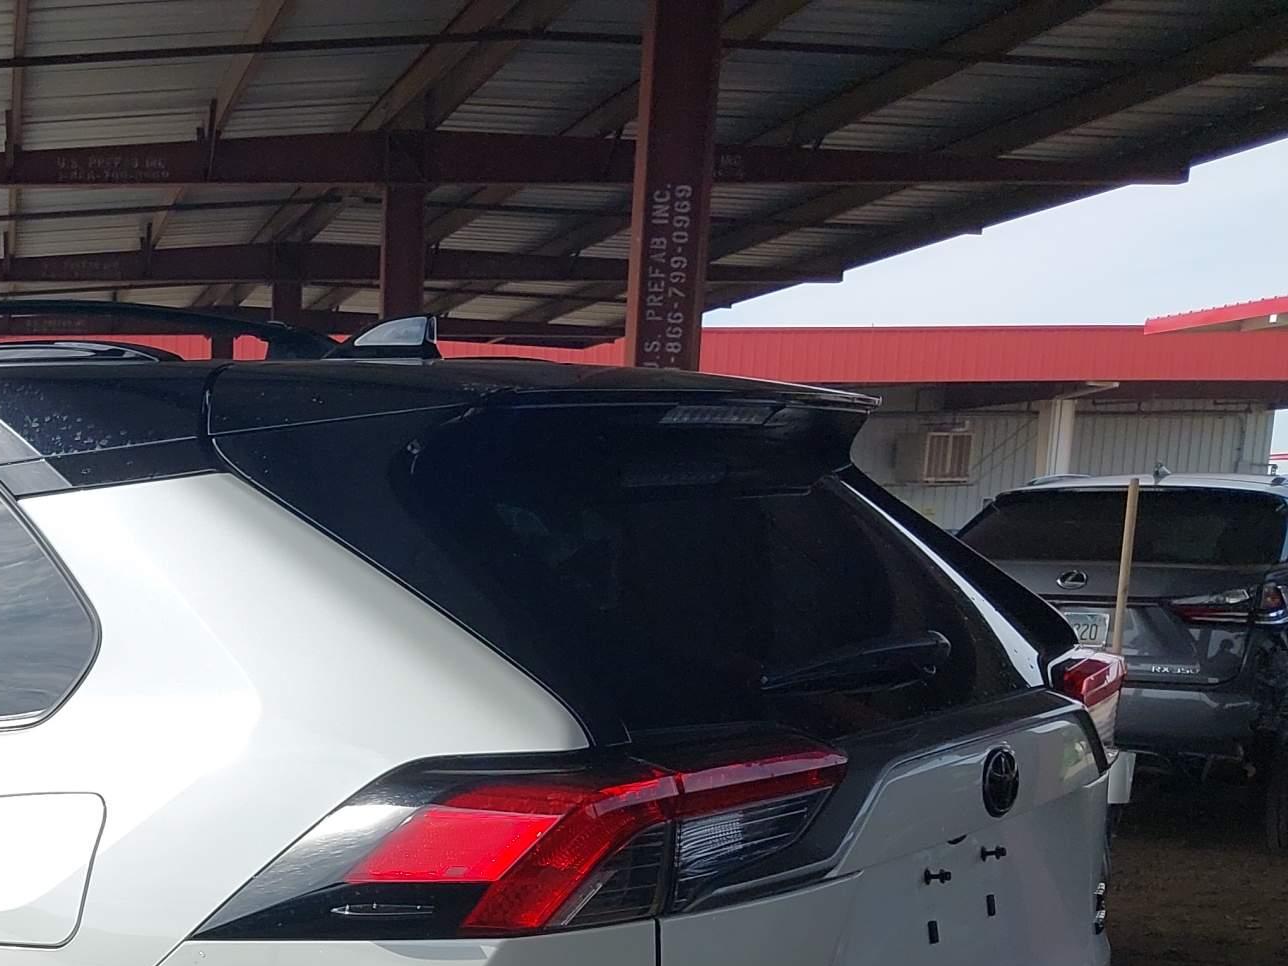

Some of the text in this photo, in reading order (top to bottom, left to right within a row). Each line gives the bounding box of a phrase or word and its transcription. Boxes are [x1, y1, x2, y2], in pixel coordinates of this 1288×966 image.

[652, 184, 672, 225] INC.
[646, 236, 667, 321] PREFAB
[1152, 664, 1170, 673] RX
